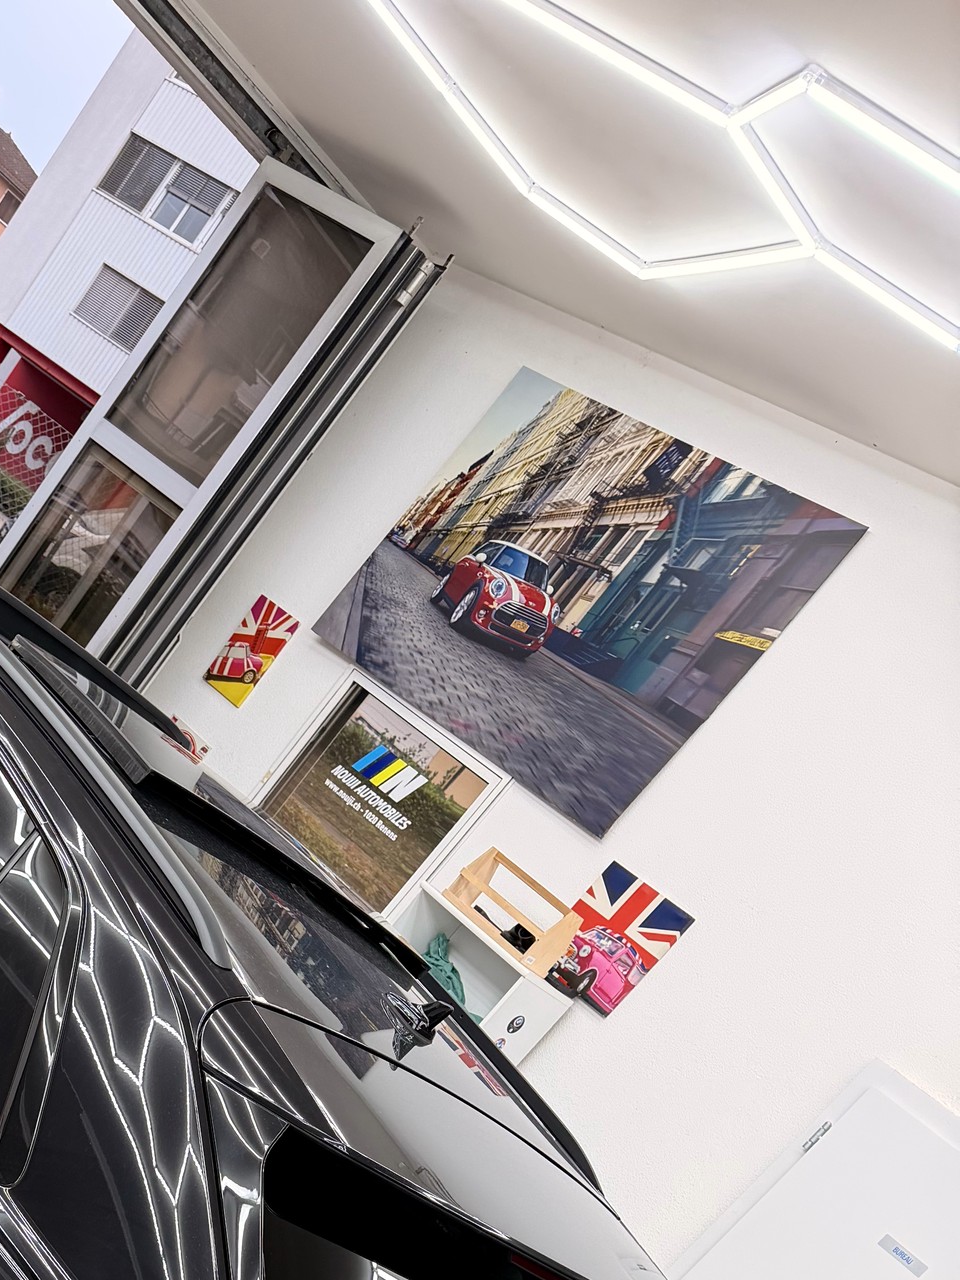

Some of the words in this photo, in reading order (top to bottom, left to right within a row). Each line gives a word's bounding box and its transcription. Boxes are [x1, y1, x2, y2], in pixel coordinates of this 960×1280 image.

[330, 764, 361, 789] NOUIJI
[353, 783, 412, 832] AUTOMOBILES
[361, 808, 379, 825] 1020
[374, 819, 398, 841] Renens
[892, 1246, 914, 1265] BUREAU
